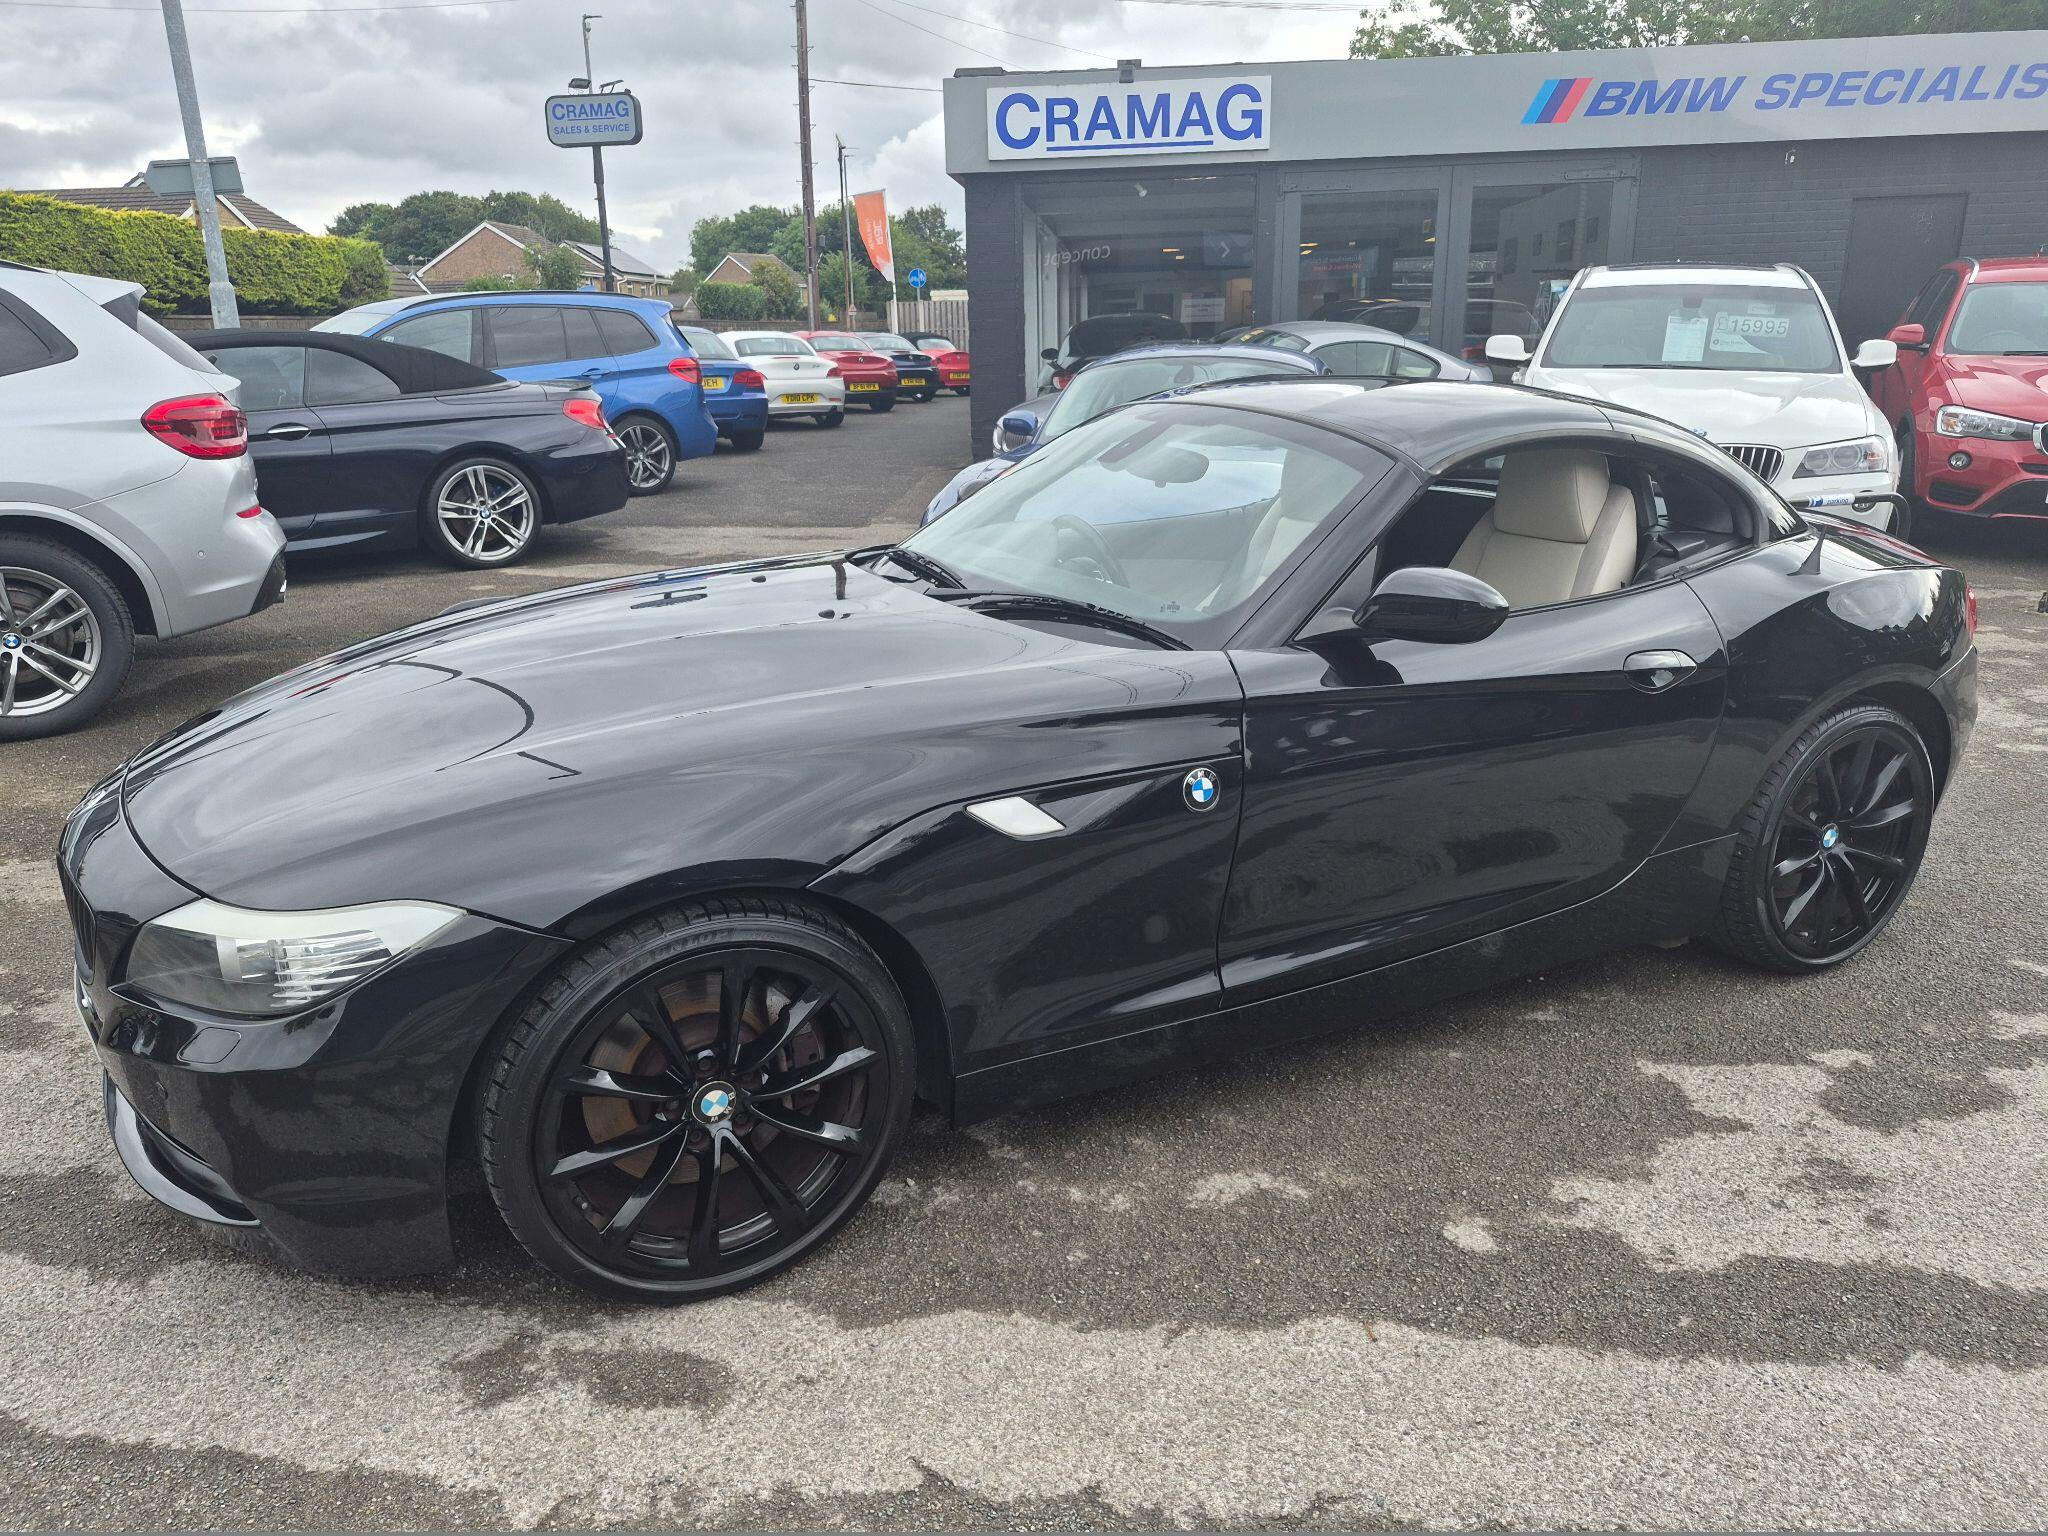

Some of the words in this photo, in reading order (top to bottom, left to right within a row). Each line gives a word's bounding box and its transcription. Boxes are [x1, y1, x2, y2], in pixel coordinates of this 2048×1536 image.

[1583, 76, 1746, 117] BMW
[1755, 63, 2048, 112] SPECIALIS
[552, 100, 629, 120] CRAMAG
[995, 83, 1263, 150] CRAMAG
[554, 125, 582, 135] SALES
[585, 125, 591, 134] &
[593, 123, 630, 133] SERVICE
